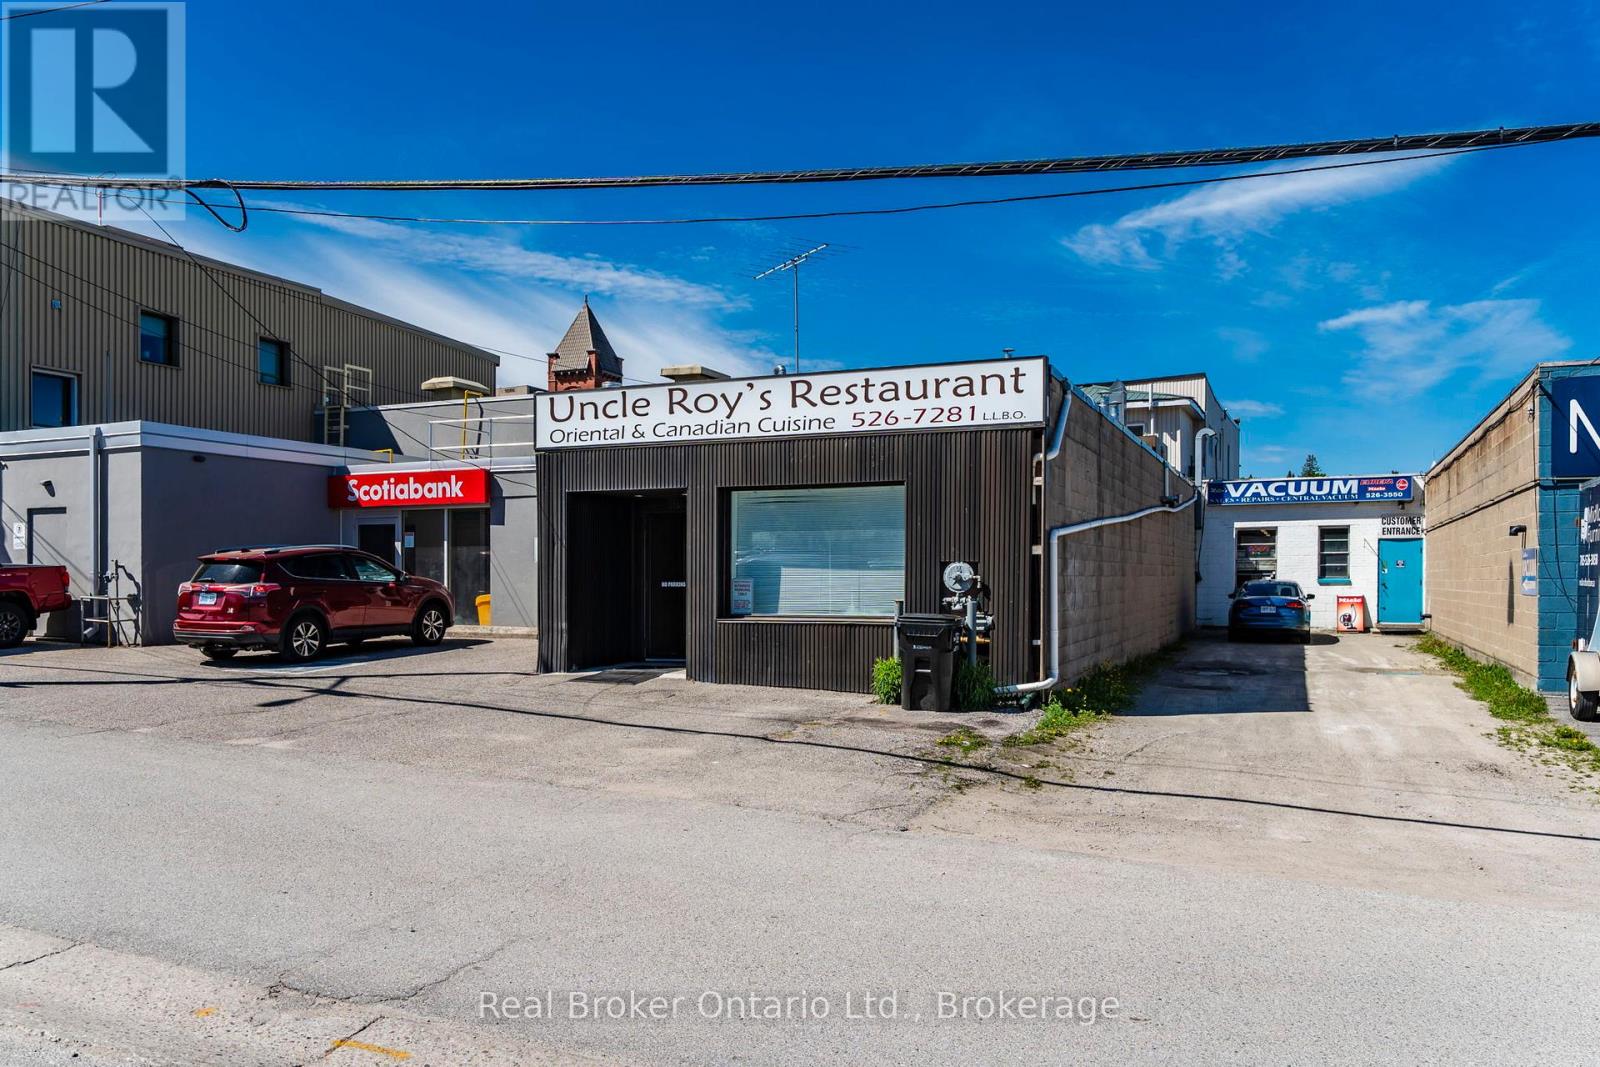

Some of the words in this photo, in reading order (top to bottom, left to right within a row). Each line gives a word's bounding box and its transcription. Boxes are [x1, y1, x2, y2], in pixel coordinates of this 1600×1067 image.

[549, 391, 650, 422] Uncle
[668, 382, 772, 419] Roy's
[790, 367, 1026, 408] Restaurant
[550, 425, 625, 443] Oriental
[632, 424, 645, 438] &
[653, 419, 750, 437] Canadian
[758, 414, 836, 432] Cuisine
[852, 405, 976, 427] 526-7281
[983, 410, 1026, 421] L.L.B.O.
[347, 474, 464, 502] Scotiabank
[1226, 480, 1358, 497] VACUUM
[1381, 516, 1421, 525] CUSTOMER
[1382, 527, 1420, 536] ENTRANCE
